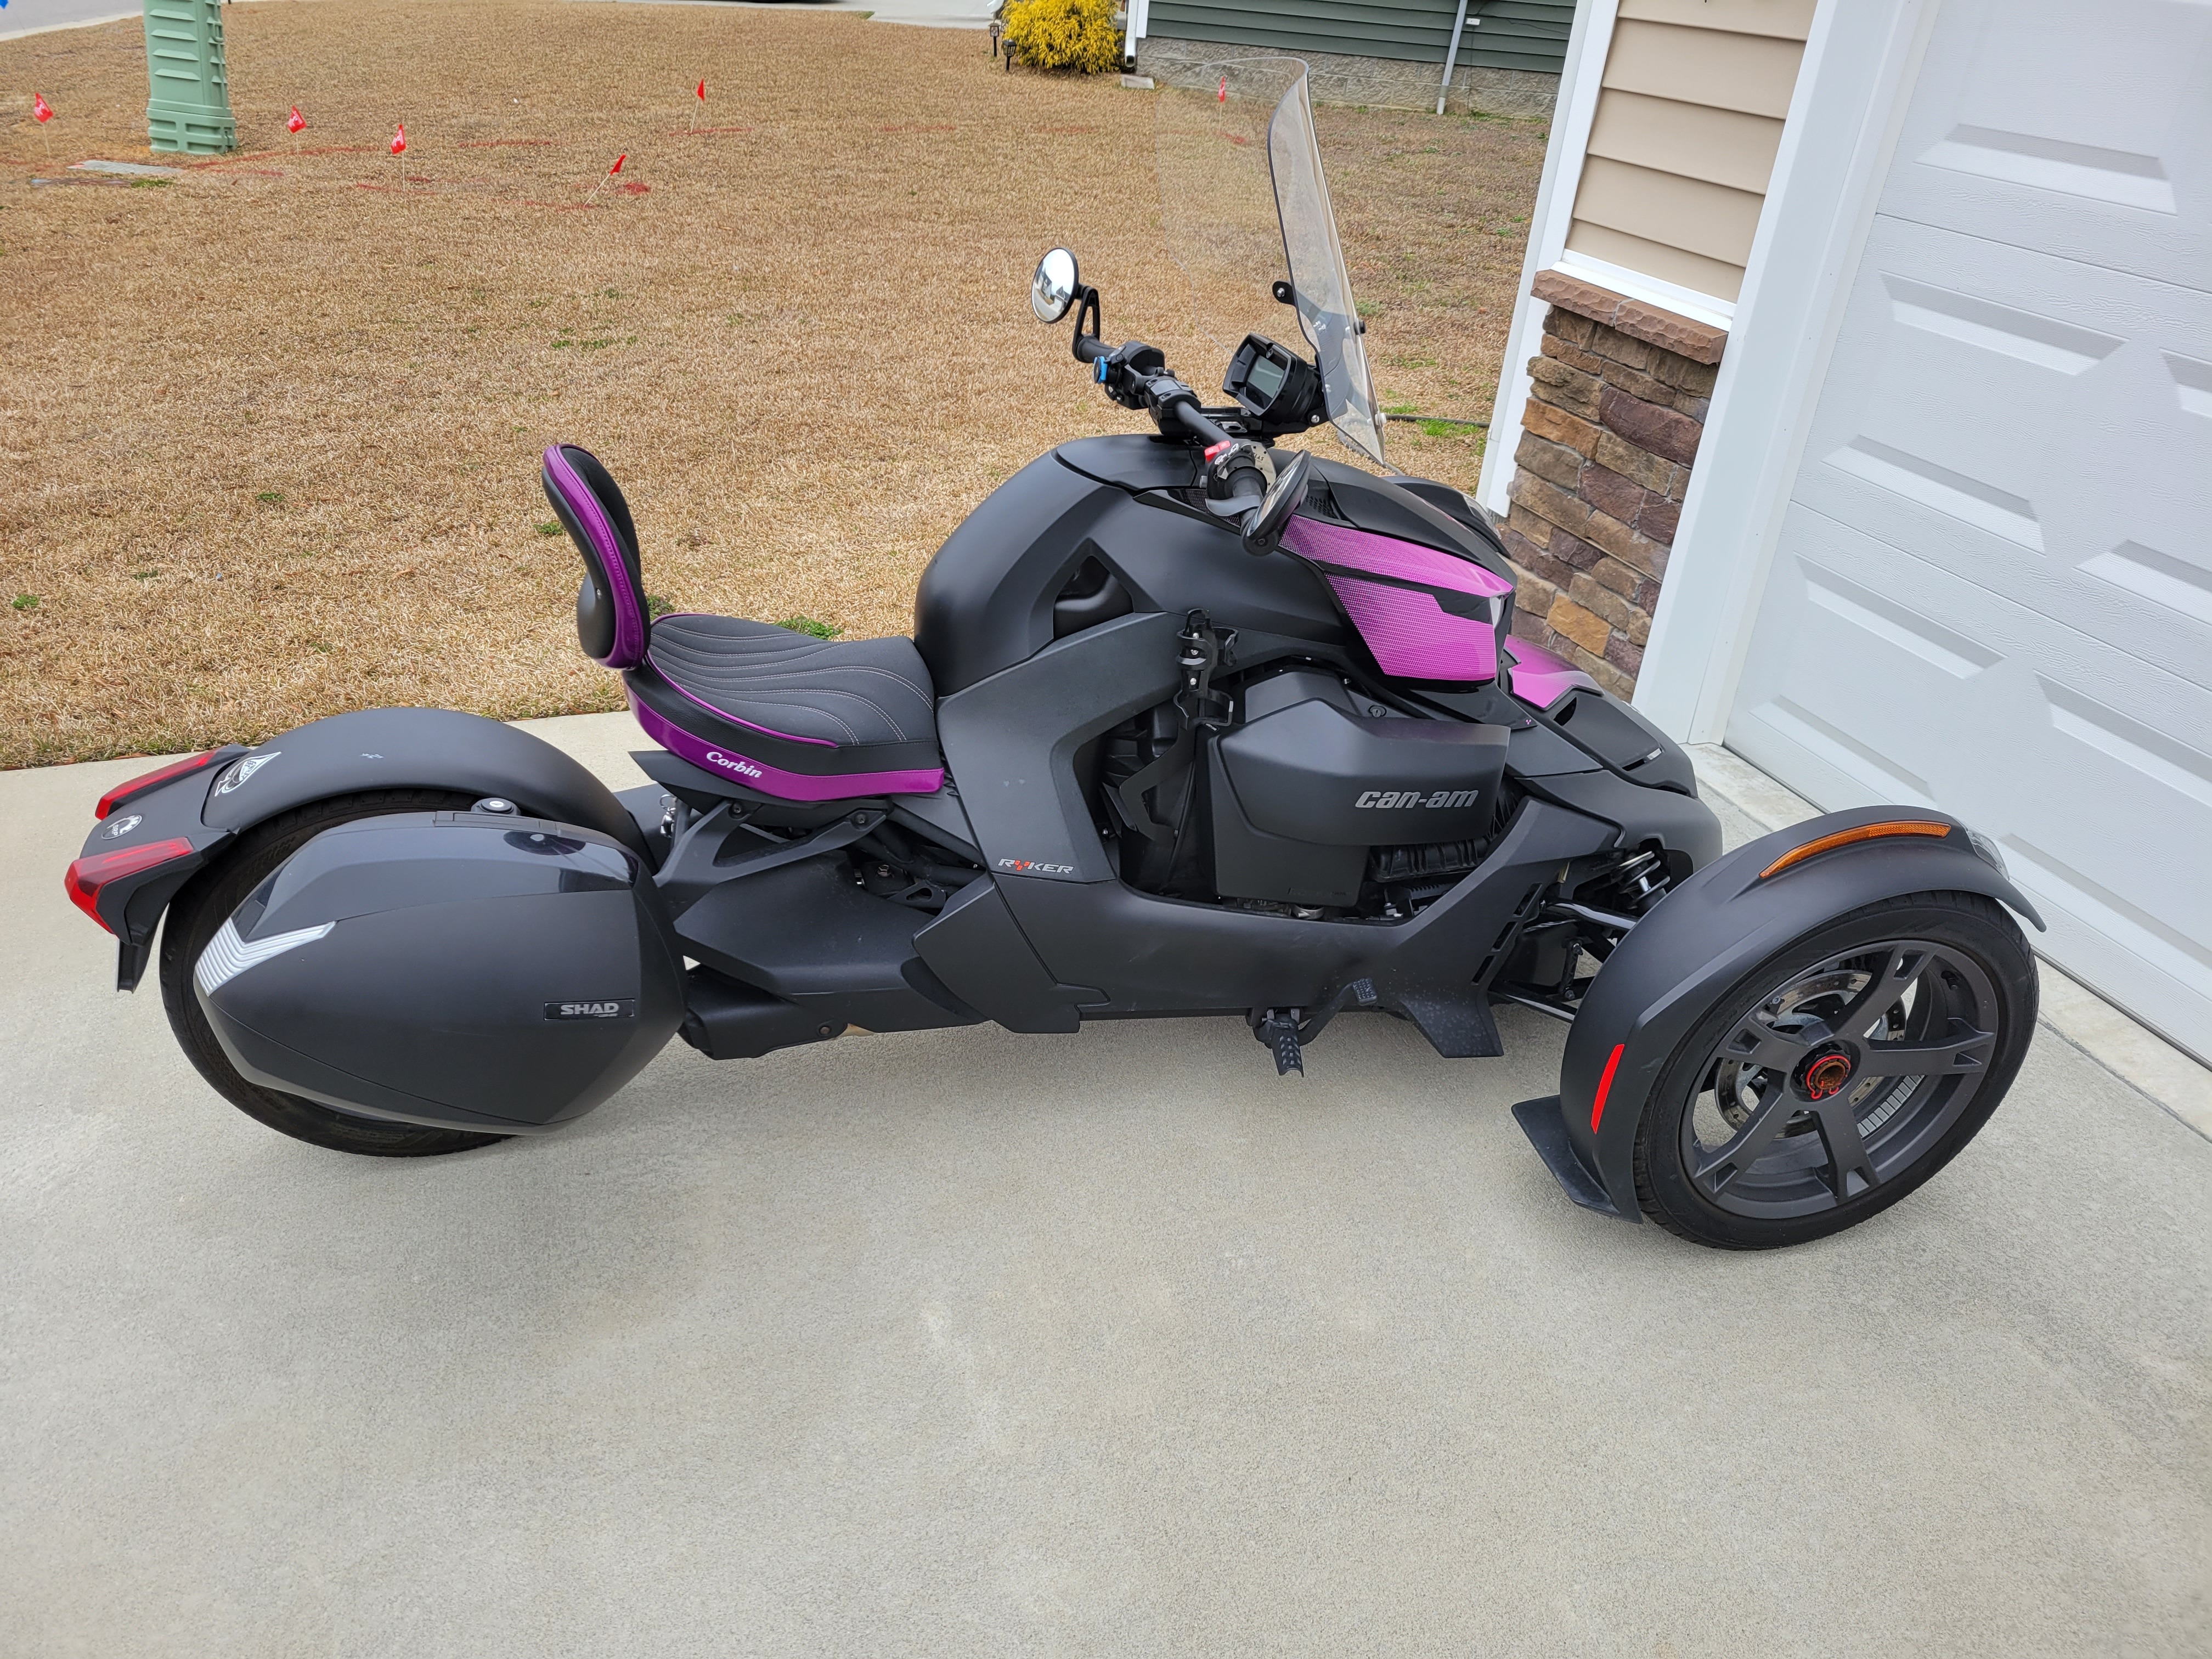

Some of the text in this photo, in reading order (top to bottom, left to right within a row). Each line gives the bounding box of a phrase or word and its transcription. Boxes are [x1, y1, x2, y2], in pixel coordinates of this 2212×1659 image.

[706, 751, 763, 778] Corbin
[997, 858, 1074, 874] RYKER
[560, 1002, 619, 1015] SHAD
